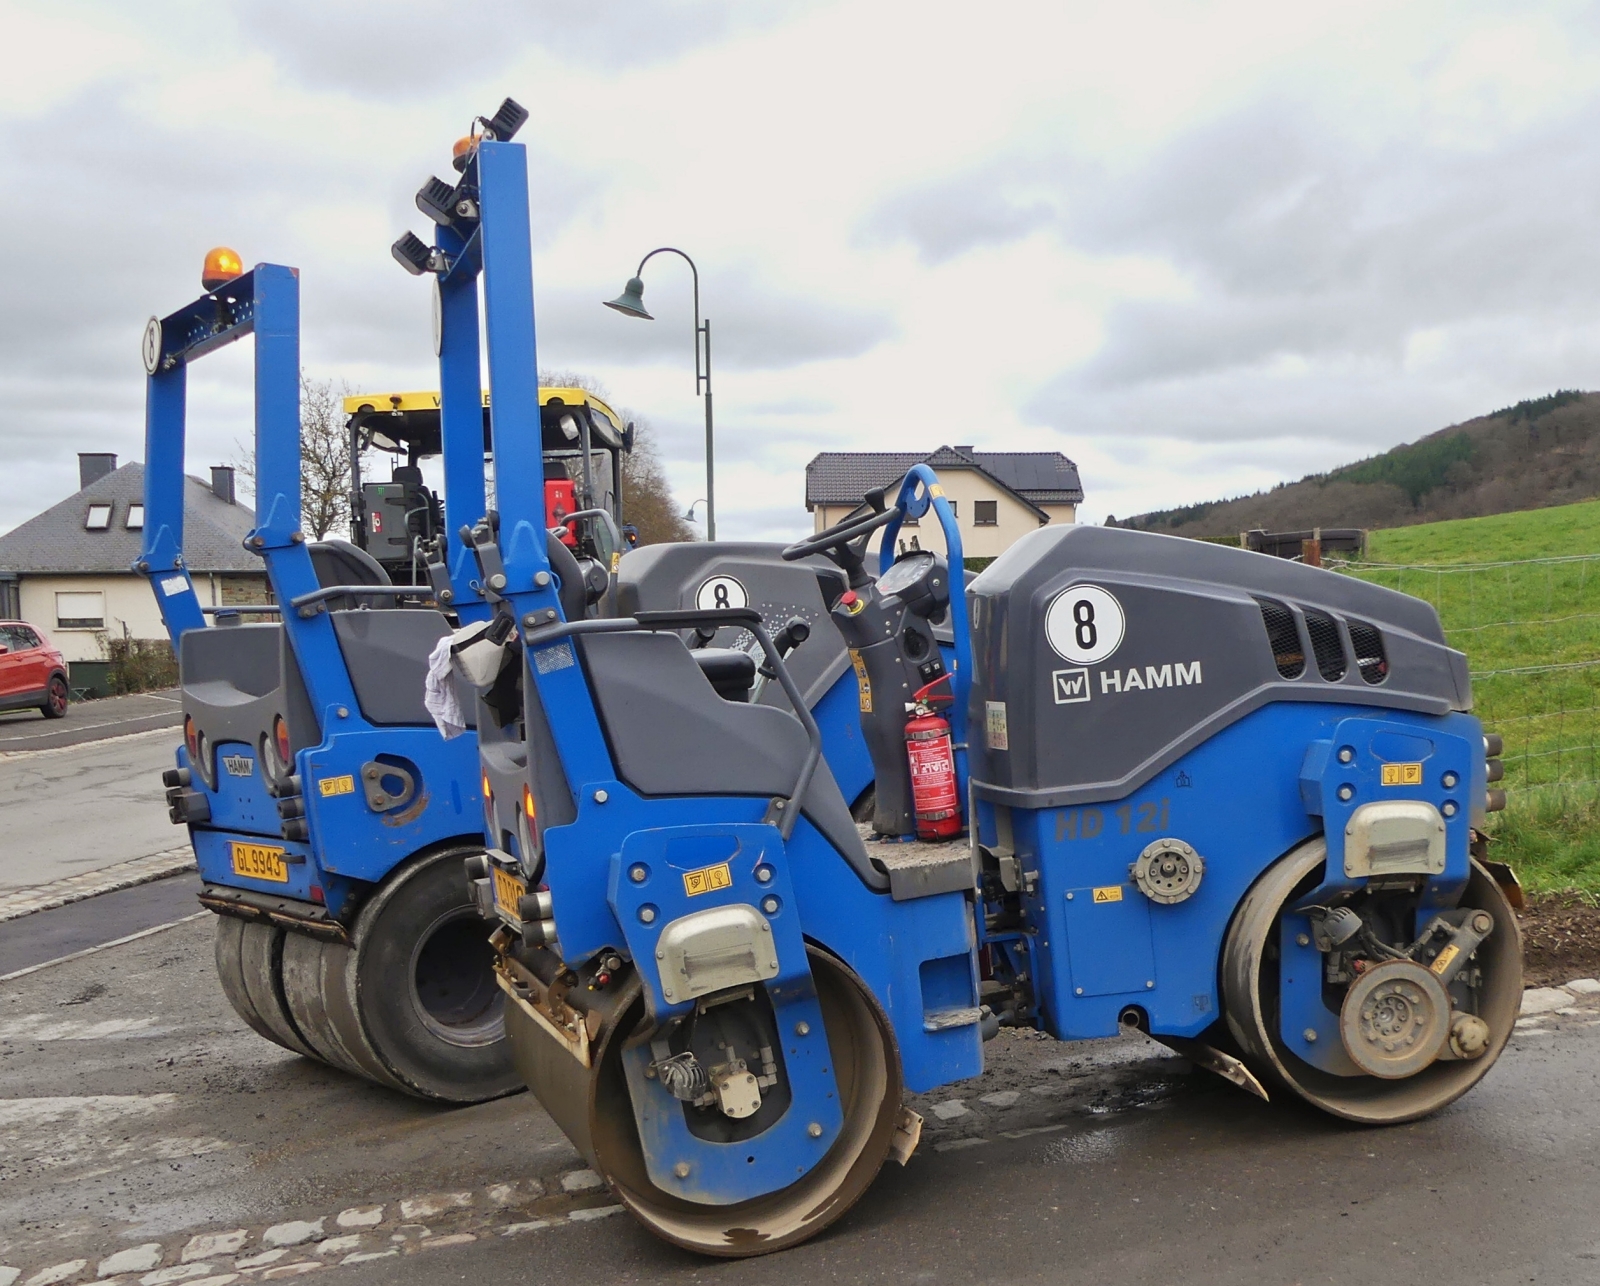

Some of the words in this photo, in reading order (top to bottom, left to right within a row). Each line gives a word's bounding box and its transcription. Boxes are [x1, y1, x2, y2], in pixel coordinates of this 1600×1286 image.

[713, 583, 731, 608] 8
[1073, 599, 1097, 650] 8
[1100, 660, 1202, 694] HAMM
[227, 758, 251, 774] HAMM
[1055, 807, 1104, 842] HD
[1115, 797, 1171, 835] 12i
[236, 847, 251, 872] GL
[252, 848, 281, 877] 9943
